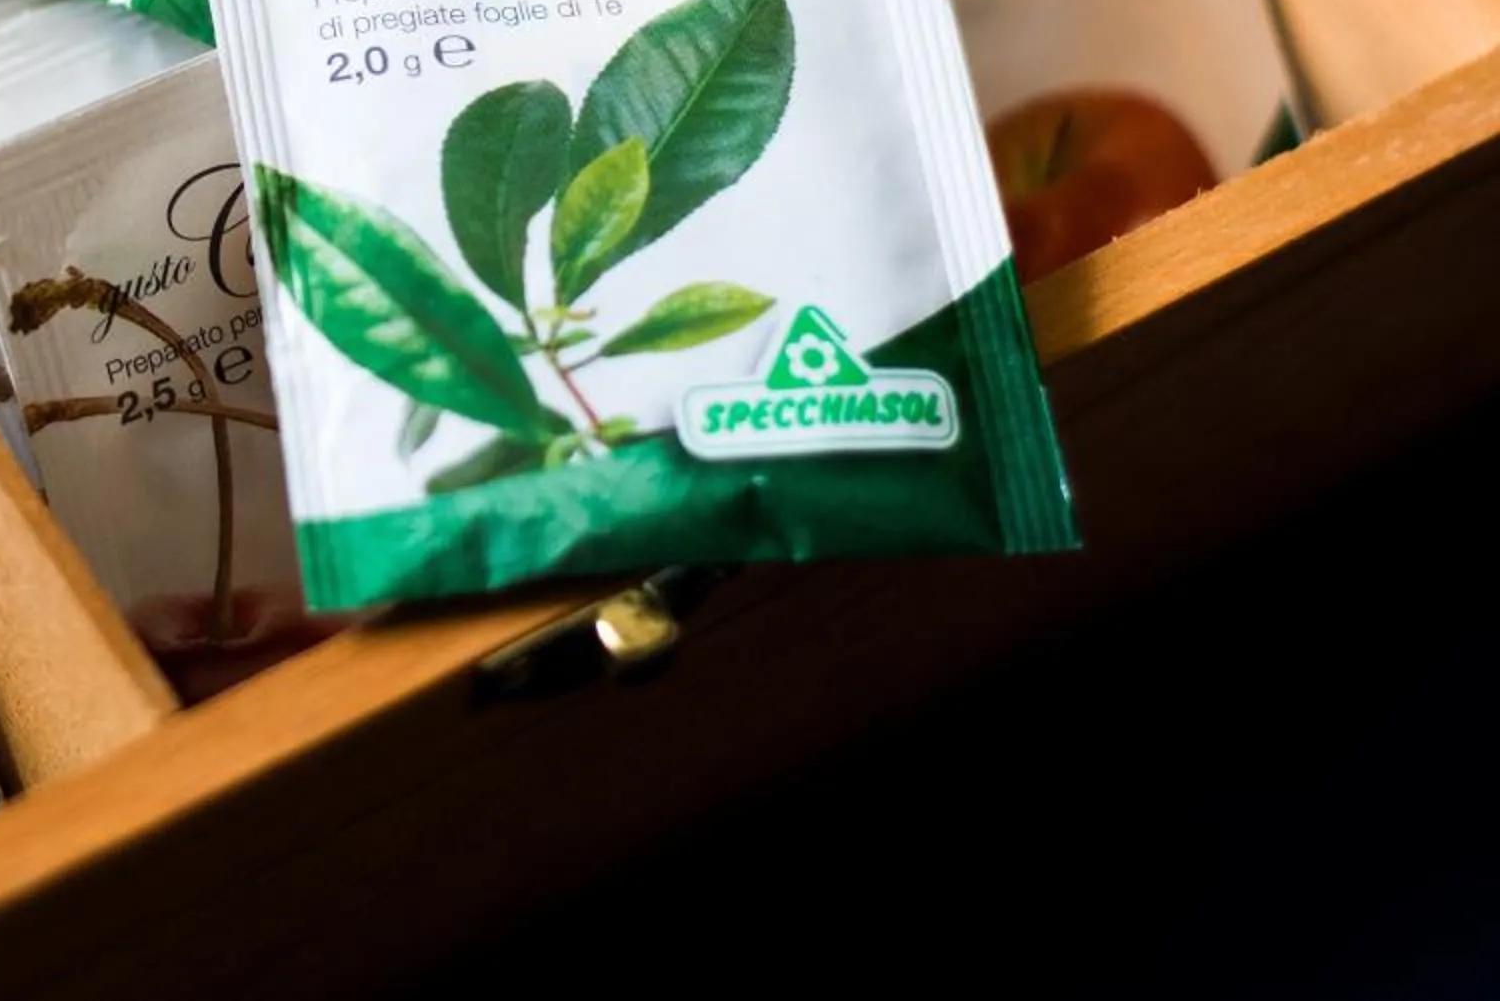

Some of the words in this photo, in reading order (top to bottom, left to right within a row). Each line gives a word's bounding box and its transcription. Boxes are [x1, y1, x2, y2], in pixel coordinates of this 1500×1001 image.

[319, 15, 343, 40] di
[353, 4, 466, 39] pregiate
[475, 0, 548, 27] foglie
[327, 46, 389, 85] 2,0
[403, 54, 422, 78] g
[91, 255, 196, 343] gusto
[106, 326, 223, 385] Preparato
[117, 376, 176, 427] 2,5
[188, 379, 206, 404] g
[703, 390, 943, 434] SPECCHIASOL
